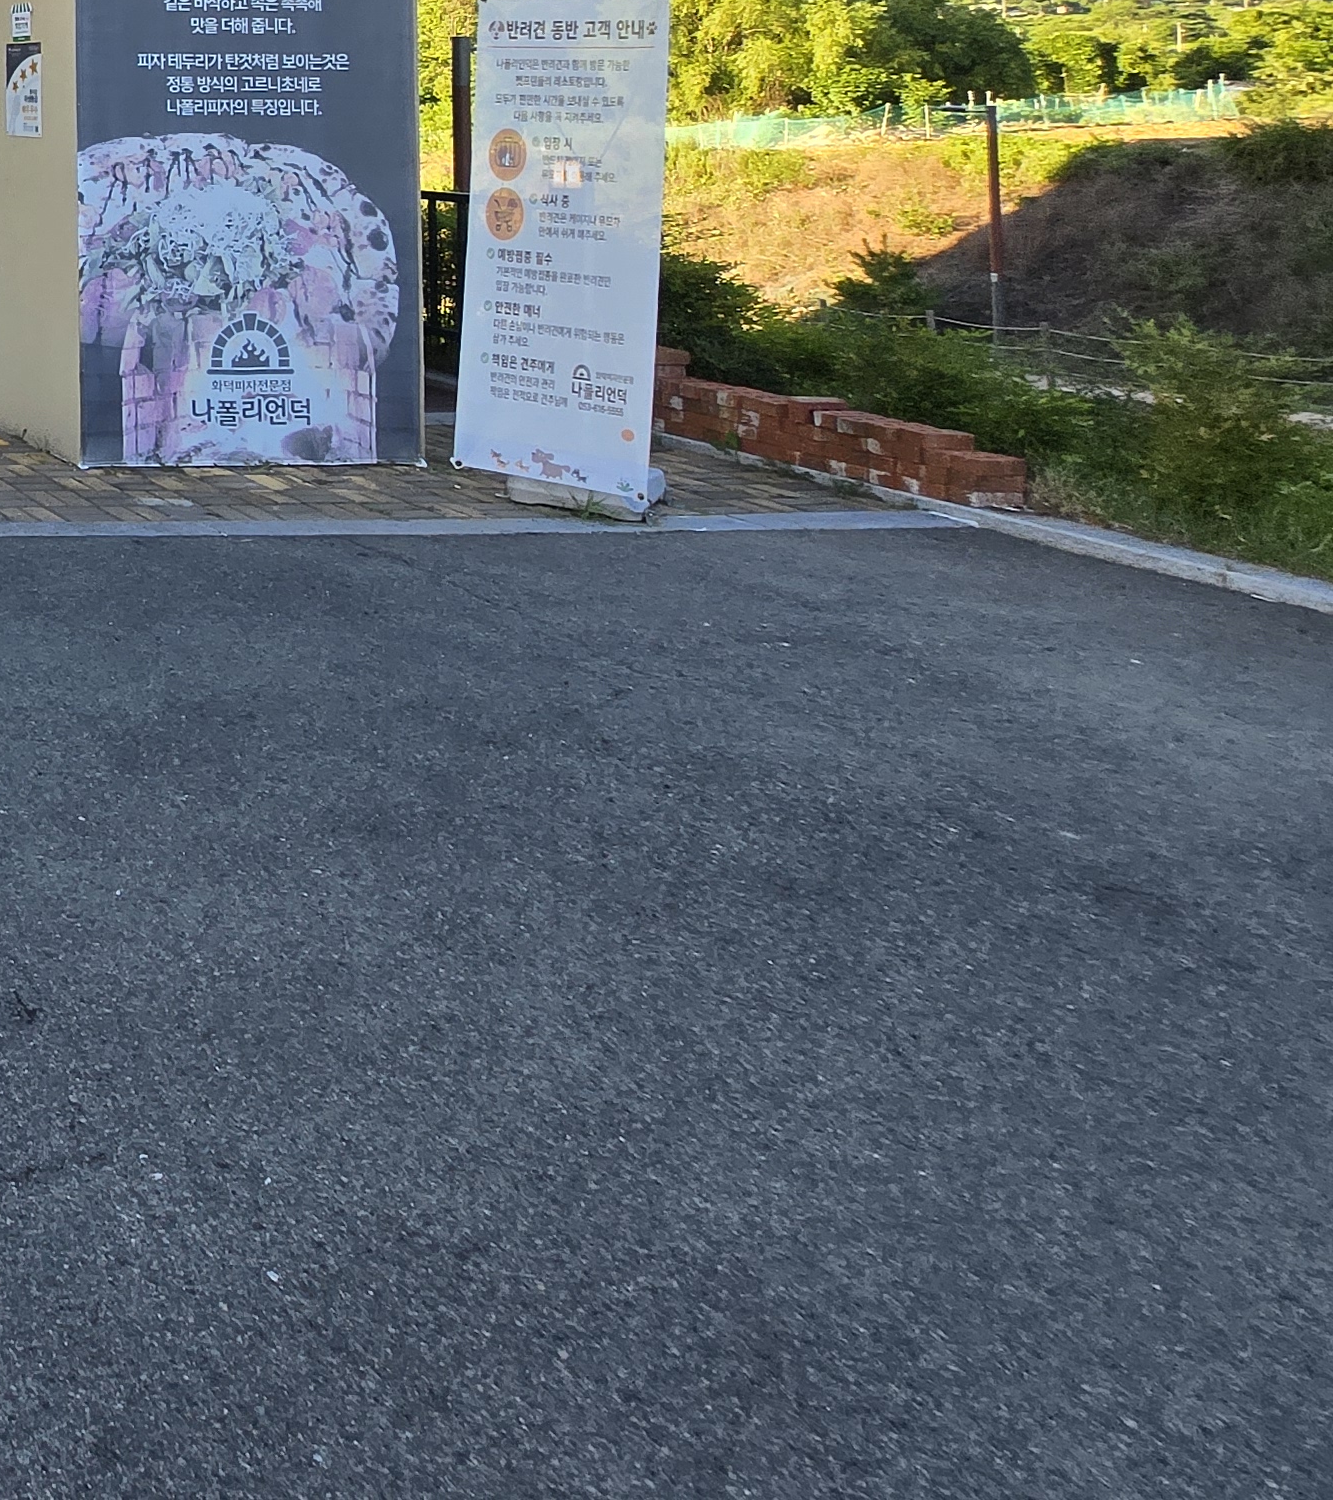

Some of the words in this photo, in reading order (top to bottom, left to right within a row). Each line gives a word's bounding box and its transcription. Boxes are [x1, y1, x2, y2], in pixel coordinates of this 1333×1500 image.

[190, 17, 219, 34] 맛을
[221, 17, 248, 34] 더해
[251, 17, 296, 34] 줍니다.
[506, 19, 546, 40] 반려견
[551, 20, 579, 41] 동반
[583, 19, 611, 40] 고객
[616, 19, 645, 40] 안내
[137, 53, 166, 70] 피자
[168, 53, 223, 70] 테두리가
[225, 53, 278, 70] 탄것처럼
[282, 53, 350, 70] 보이는것은
[166, 76, 194, 93] 정통
[197, 76, 237, 93] 방식의
[240, 76, 322, 93] 고르니초네로
[167, 99, 248, 116] 나폴리피자의
[251, 99, 323, 116] 특징입니다.
[497, 248, 532, 263] 예방접종
[536, 251, 553, 265] 필수
[495, 301, 521, 316] 안전한
[523, 303, 541, 318] 매너
[491, 353, 518, 370] 책임은
[212, 380, 291, 392] 화덕피자전문점
[571, 381, 628, 405] 나폴리언덕
[192, 398, 311, 426] 나폴리언덕
